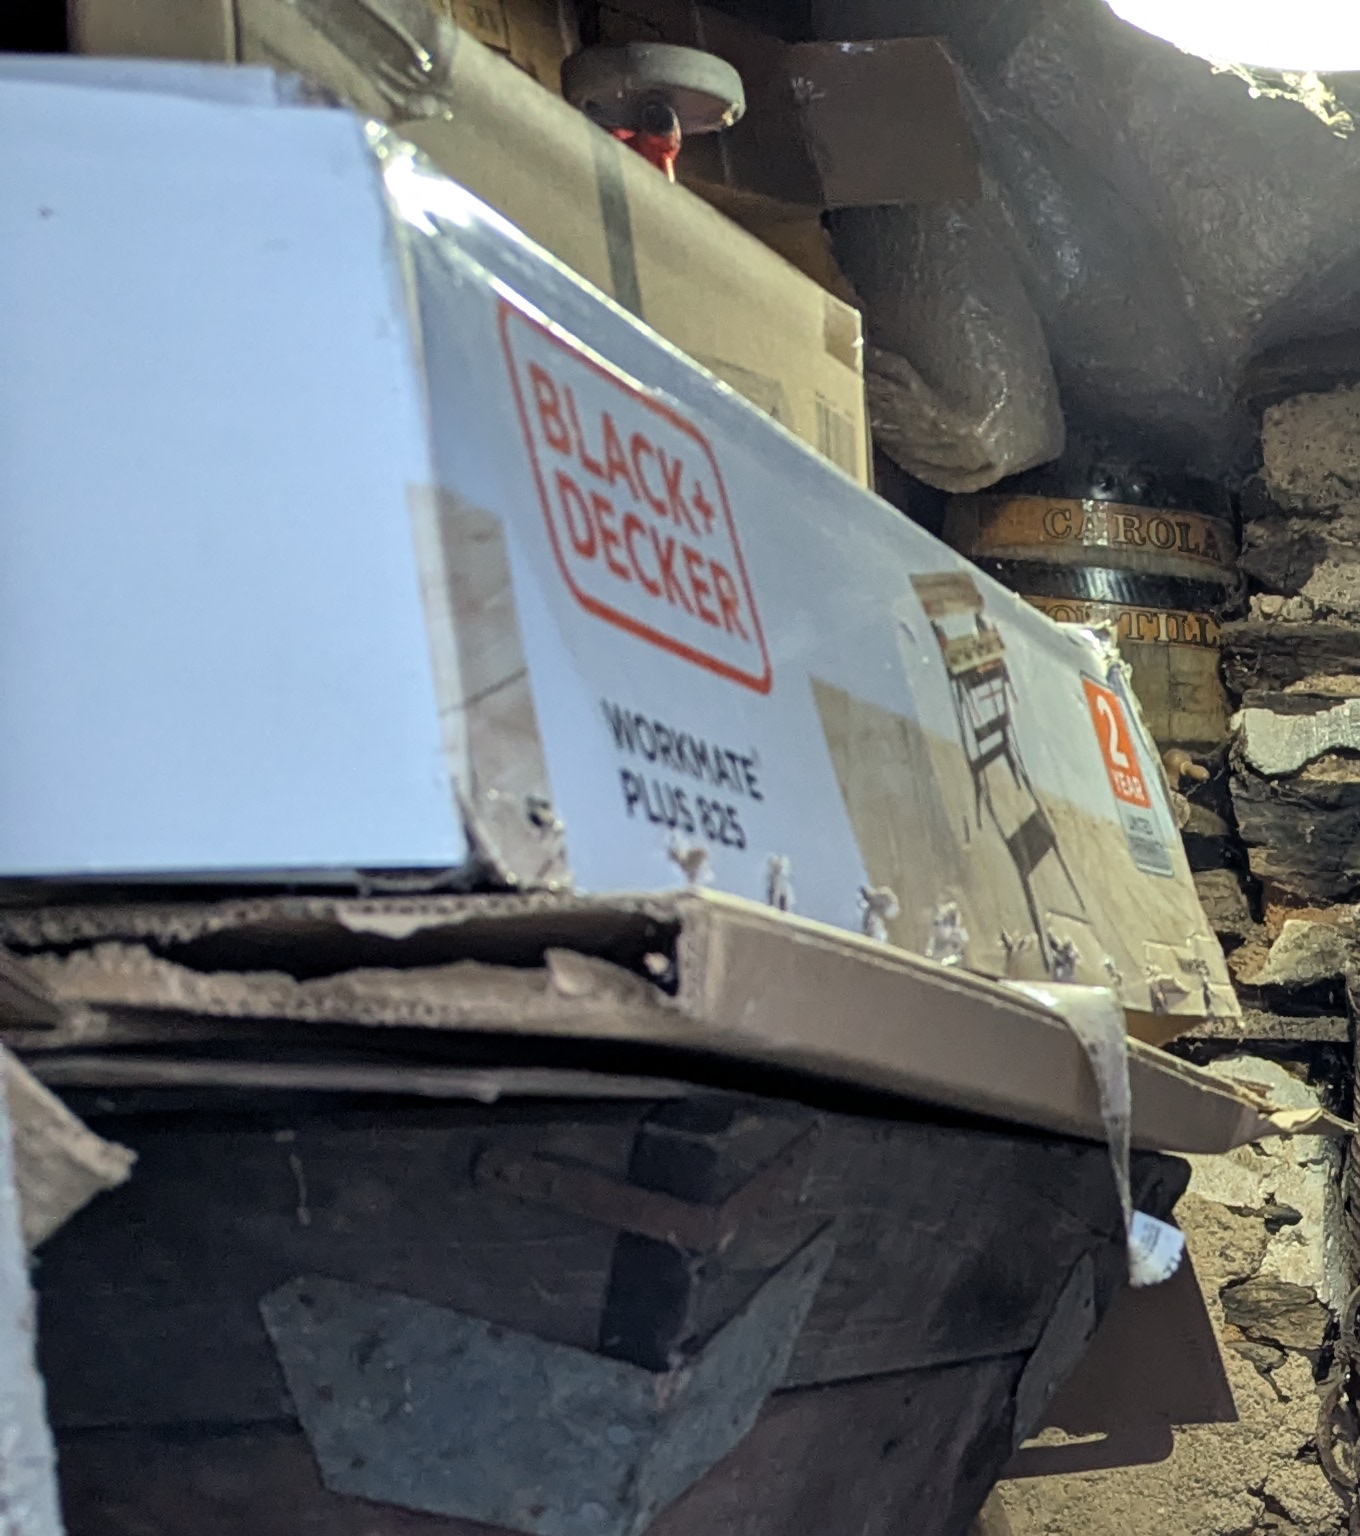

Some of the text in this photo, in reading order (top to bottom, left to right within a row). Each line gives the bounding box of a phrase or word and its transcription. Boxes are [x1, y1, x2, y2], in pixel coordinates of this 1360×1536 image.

[528, 360, 715, 535] BLACK+
[555, 468, 752, 642] DECKER
[600, 697, 764, 803] WORKMATE
[1096, 694, 1130, 768] 2
[619, 767, 747, 850] PLUS 825
